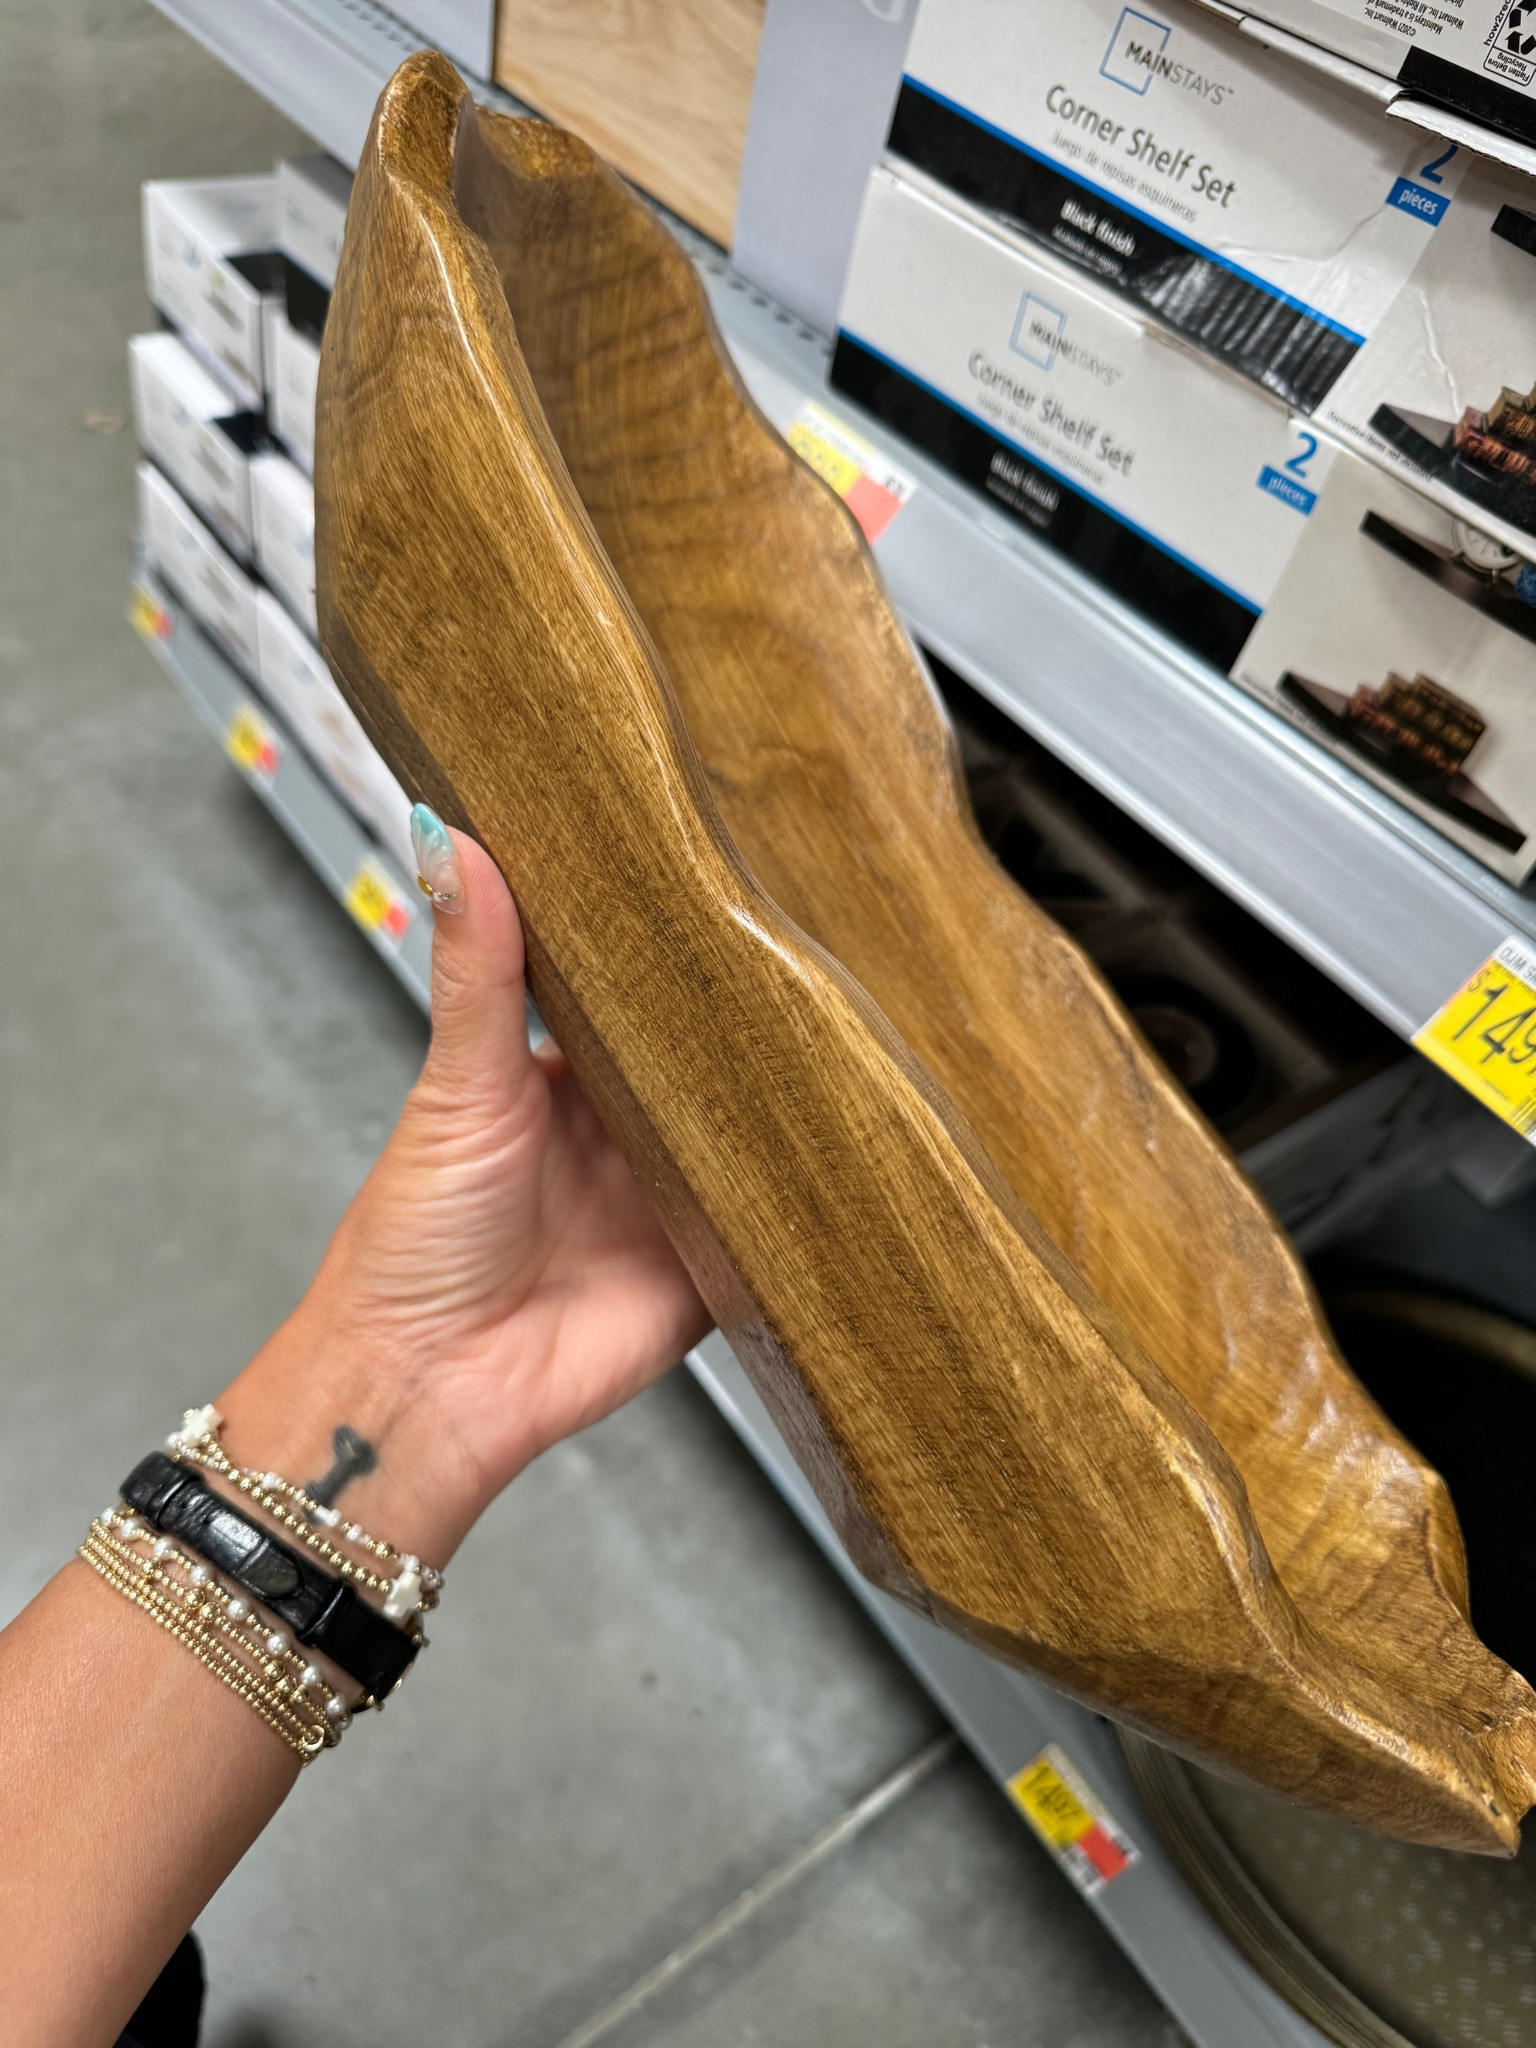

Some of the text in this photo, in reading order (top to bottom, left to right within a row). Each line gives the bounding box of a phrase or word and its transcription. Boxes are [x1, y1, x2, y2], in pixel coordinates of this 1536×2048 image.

[1375, 0, 1404, 18] trademark
[1409, 12, 1415, 23] is
[1419, 2, 1428, 14] All
[1374, 12, 1398, 29] Walmart
[1415, 15, 1444, 35] Mainstays
[1439, 11, 1464, 30] Walmart
[1488, 58, 1530, 82] Flatten Before
[1497, 52, 1527, 72] Recycling
[1046, 84, 1236, 209] Corner Shelf Set
[1419, 143, 1459, 185] 2
[1398, 188, 1438, 215] pieces
[1060, 198, 1098, 235] Black
[1095, 216, 1136, 257] finish
[968, 350, 1036, 410] Corner
[1038, 394, 1096, 449] Shelf
[1096, 431, 1135, 477] Set
[1285, 431, 1317, 478] 2
